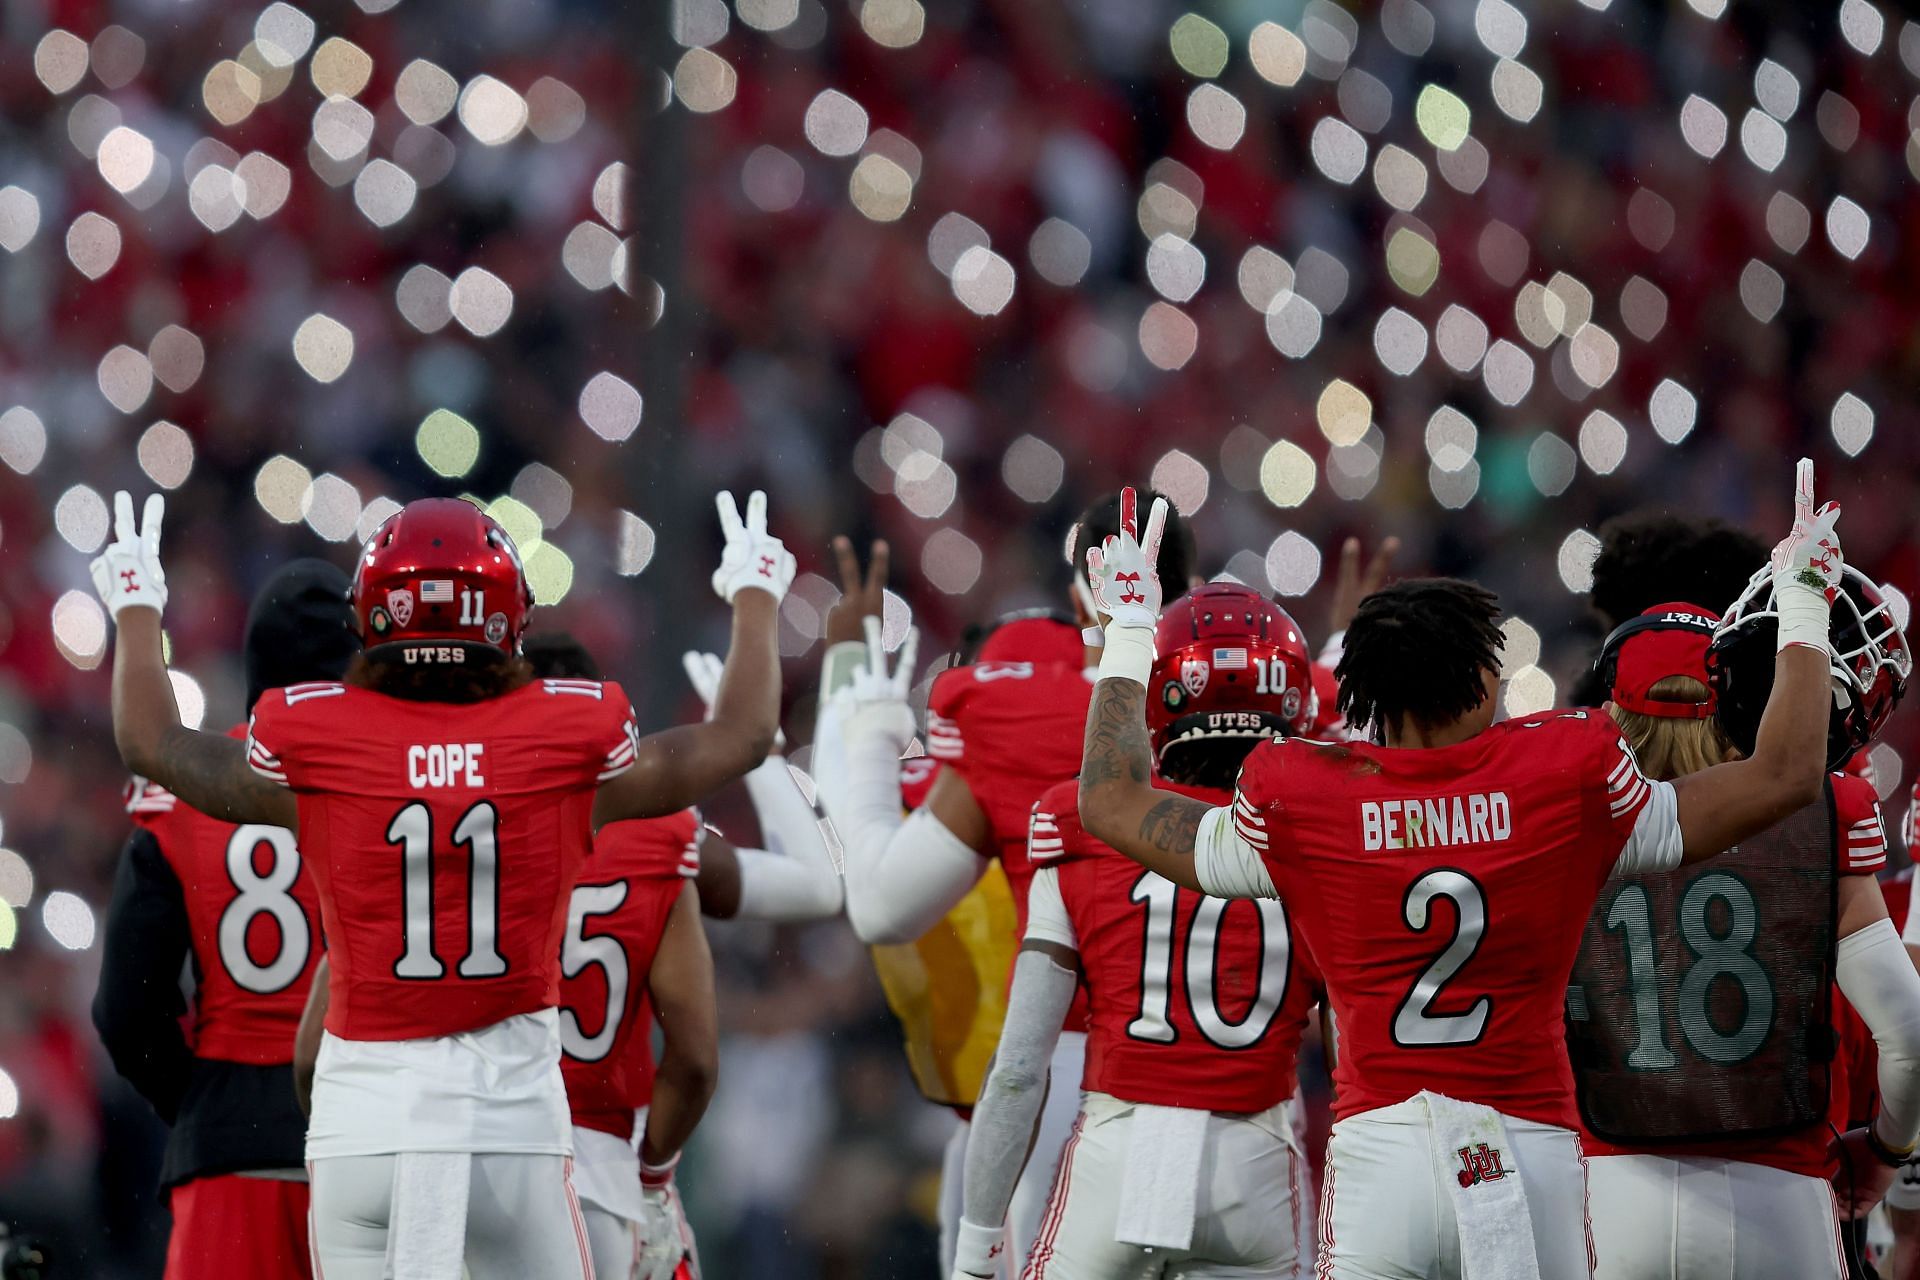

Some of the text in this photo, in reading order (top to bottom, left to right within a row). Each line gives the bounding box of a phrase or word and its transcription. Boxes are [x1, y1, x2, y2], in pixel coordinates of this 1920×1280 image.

[459, 590, 485, 626] 11
[1660, 612, 1721, 630] AT&T
[403, 647, 466, 665] UTES
[1255, 658, 1287, 694] 10
[1208, 712, 1262, 728] UTES
[407, 743, 485, 789] COPE
[1361, 791, 1512, 851] BERNARD
[218, 824, 311, 993] 8
[387, 801, 509, 979] 11
[1127, 869, 1293, 1051] 10
[1391, 867, 1494, 1049] 2
[1604, 871, 1776, 1073] 18
